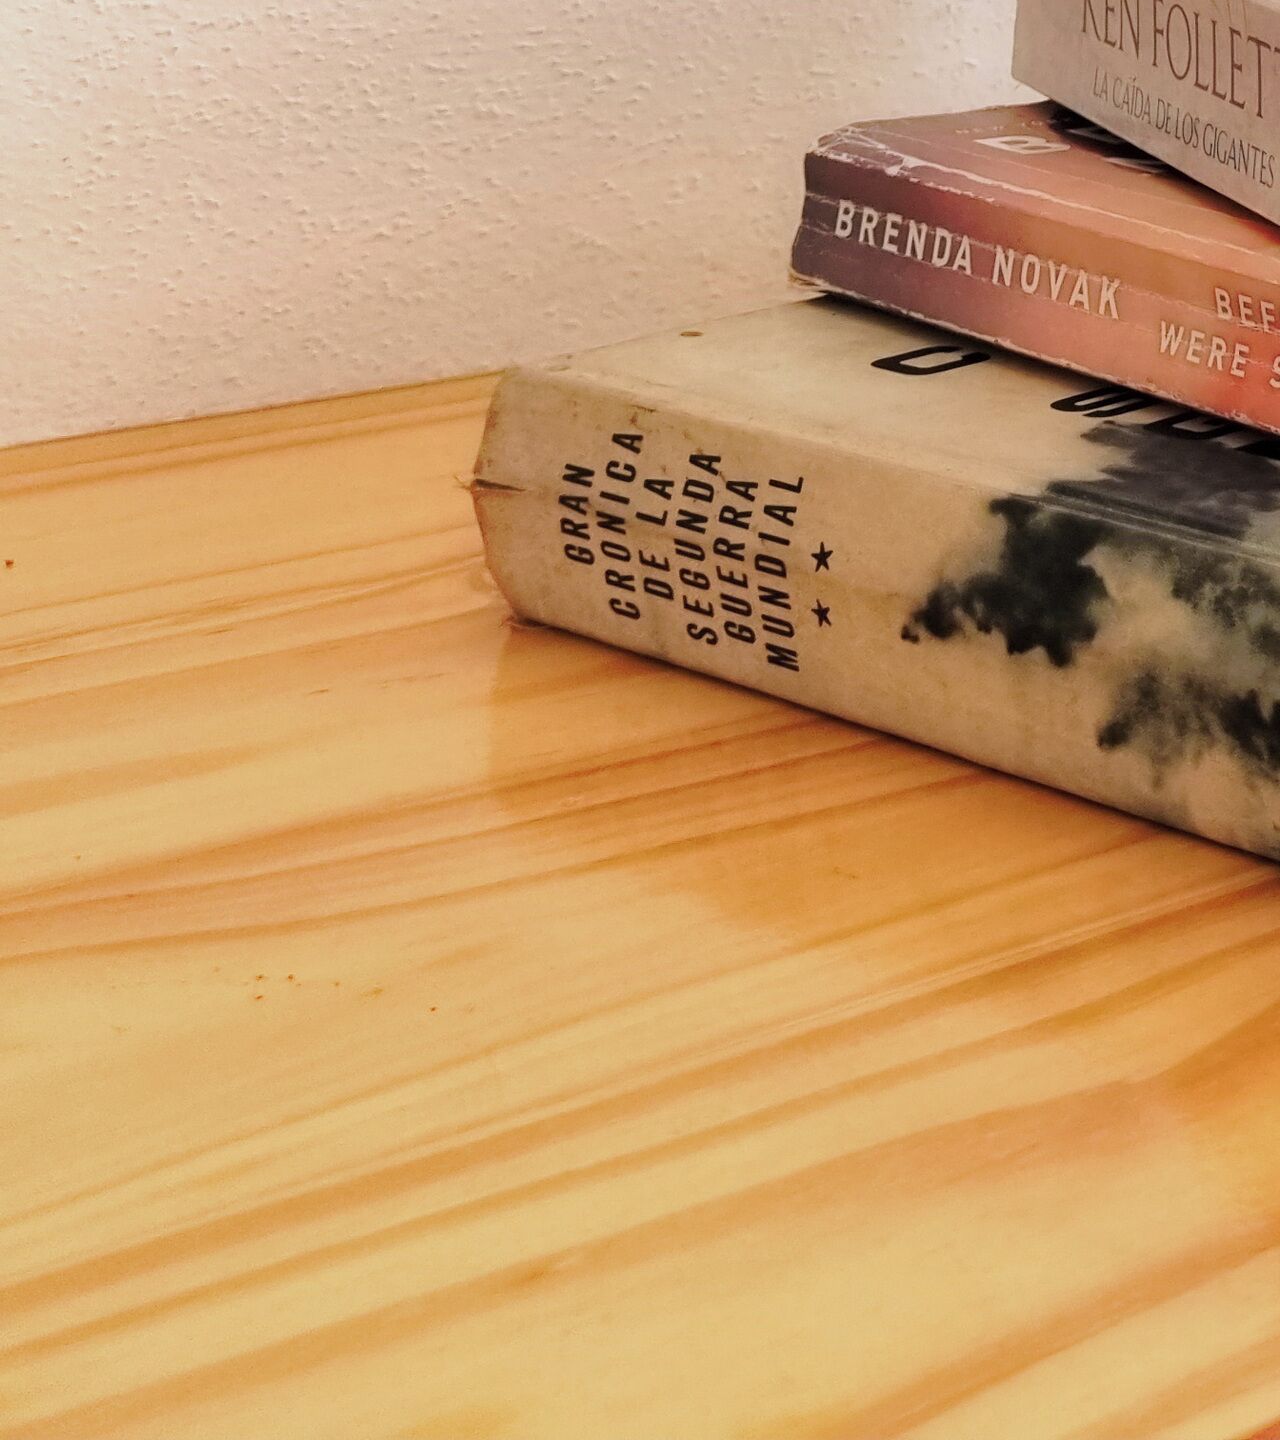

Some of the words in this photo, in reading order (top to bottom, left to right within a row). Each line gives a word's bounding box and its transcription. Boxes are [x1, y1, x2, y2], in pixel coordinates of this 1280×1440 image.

[1093, 66, 1109, 103] LA
[1113, 74, 1151, 125] CAÍDA
[1156, 98, 1171, 134] DE
[1175, 107, 1199, 149] LOS
[1203, 122, 1276, 188] GIGANTES
[835, 199, 972, 276] BRENDA
[992, 245, 1120, 319] NOVAK
[1159, 320, 1250, 378] WERE
[559, 463, 595, 566] GRAN
[596, 432, 644, 620] CRONICA
[636, 475, 675, 526] LA
[674, 454, 721, 646] SEGUNDA
[712, 478, 759, 644] GUERRA
[639, 549, 675, 601] DE
[753, 475, 804, 672] MUNDIAL
